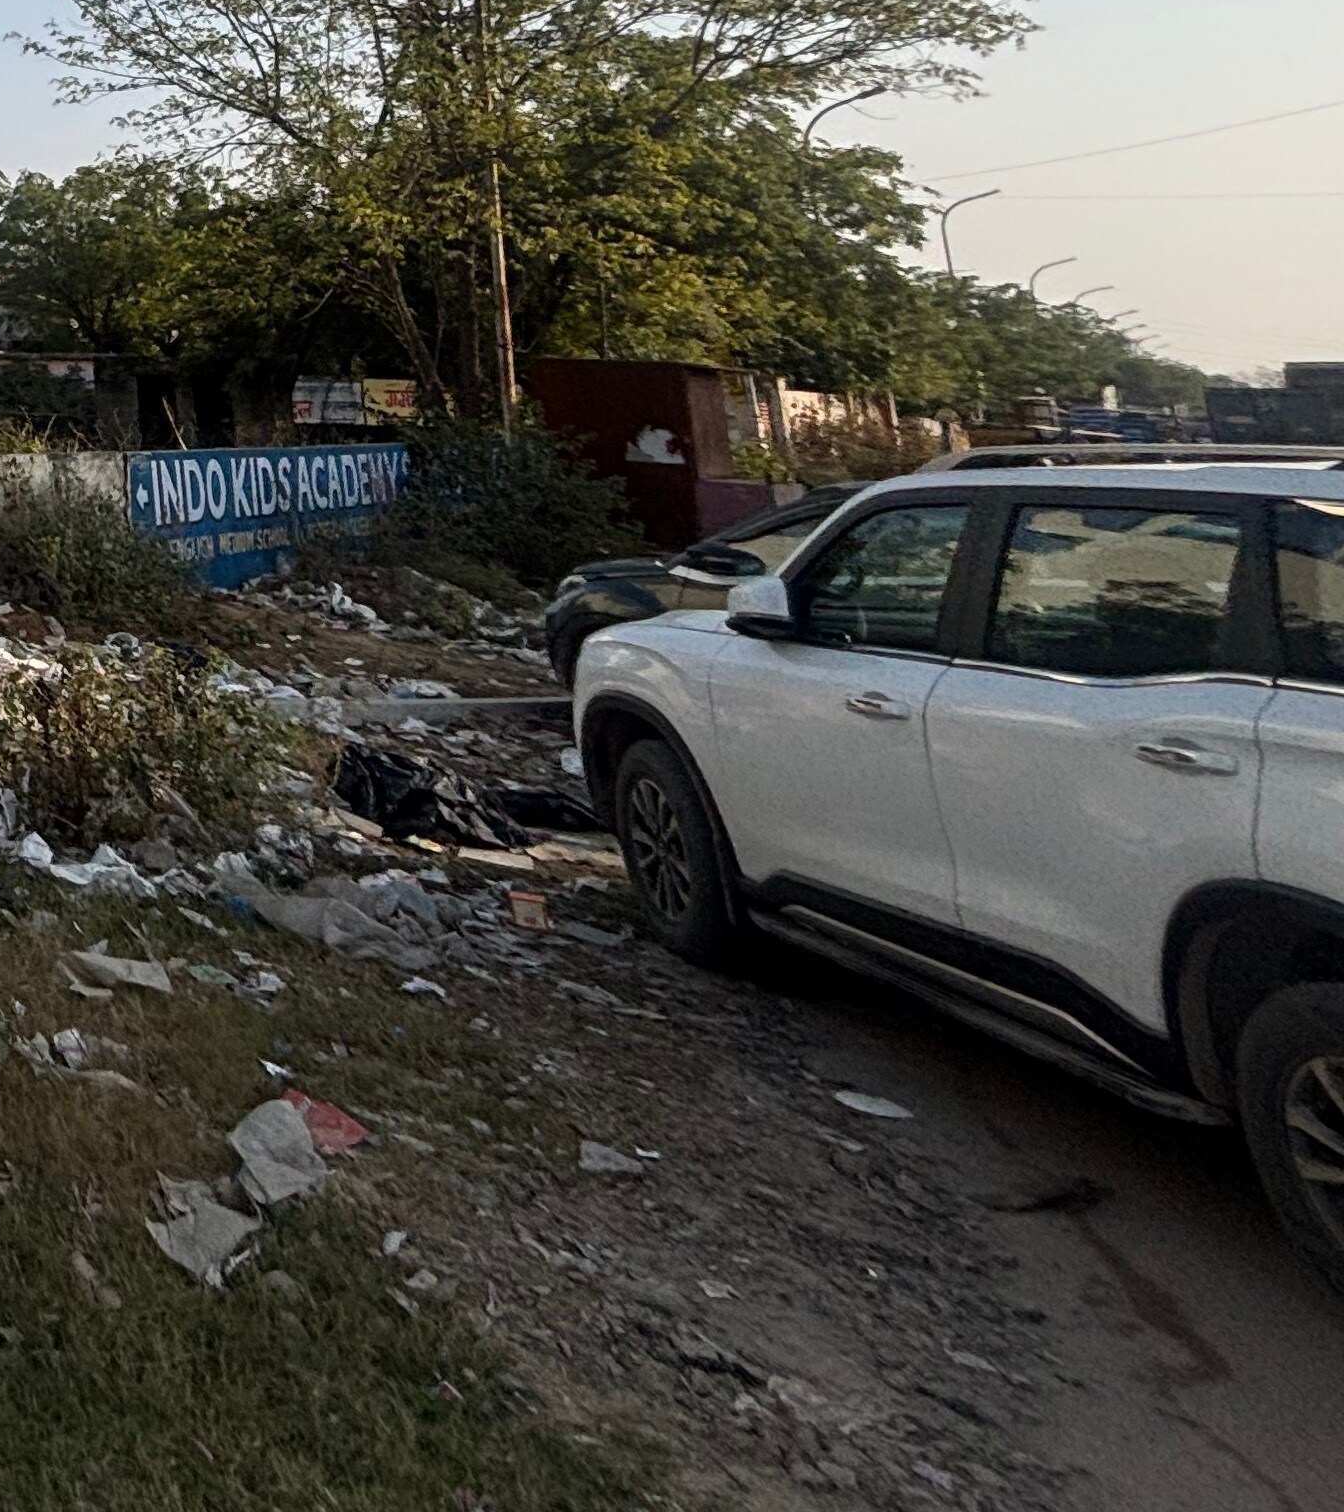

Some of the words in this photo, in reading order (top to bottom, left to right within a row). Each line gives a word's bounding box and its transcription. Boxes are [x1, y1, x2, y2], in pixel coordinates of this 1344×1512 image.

[150, 458, 227, 526] INDO
[230, 456, 292, 518] KIDS
[297, 451, 399, 513] ACADEMY
